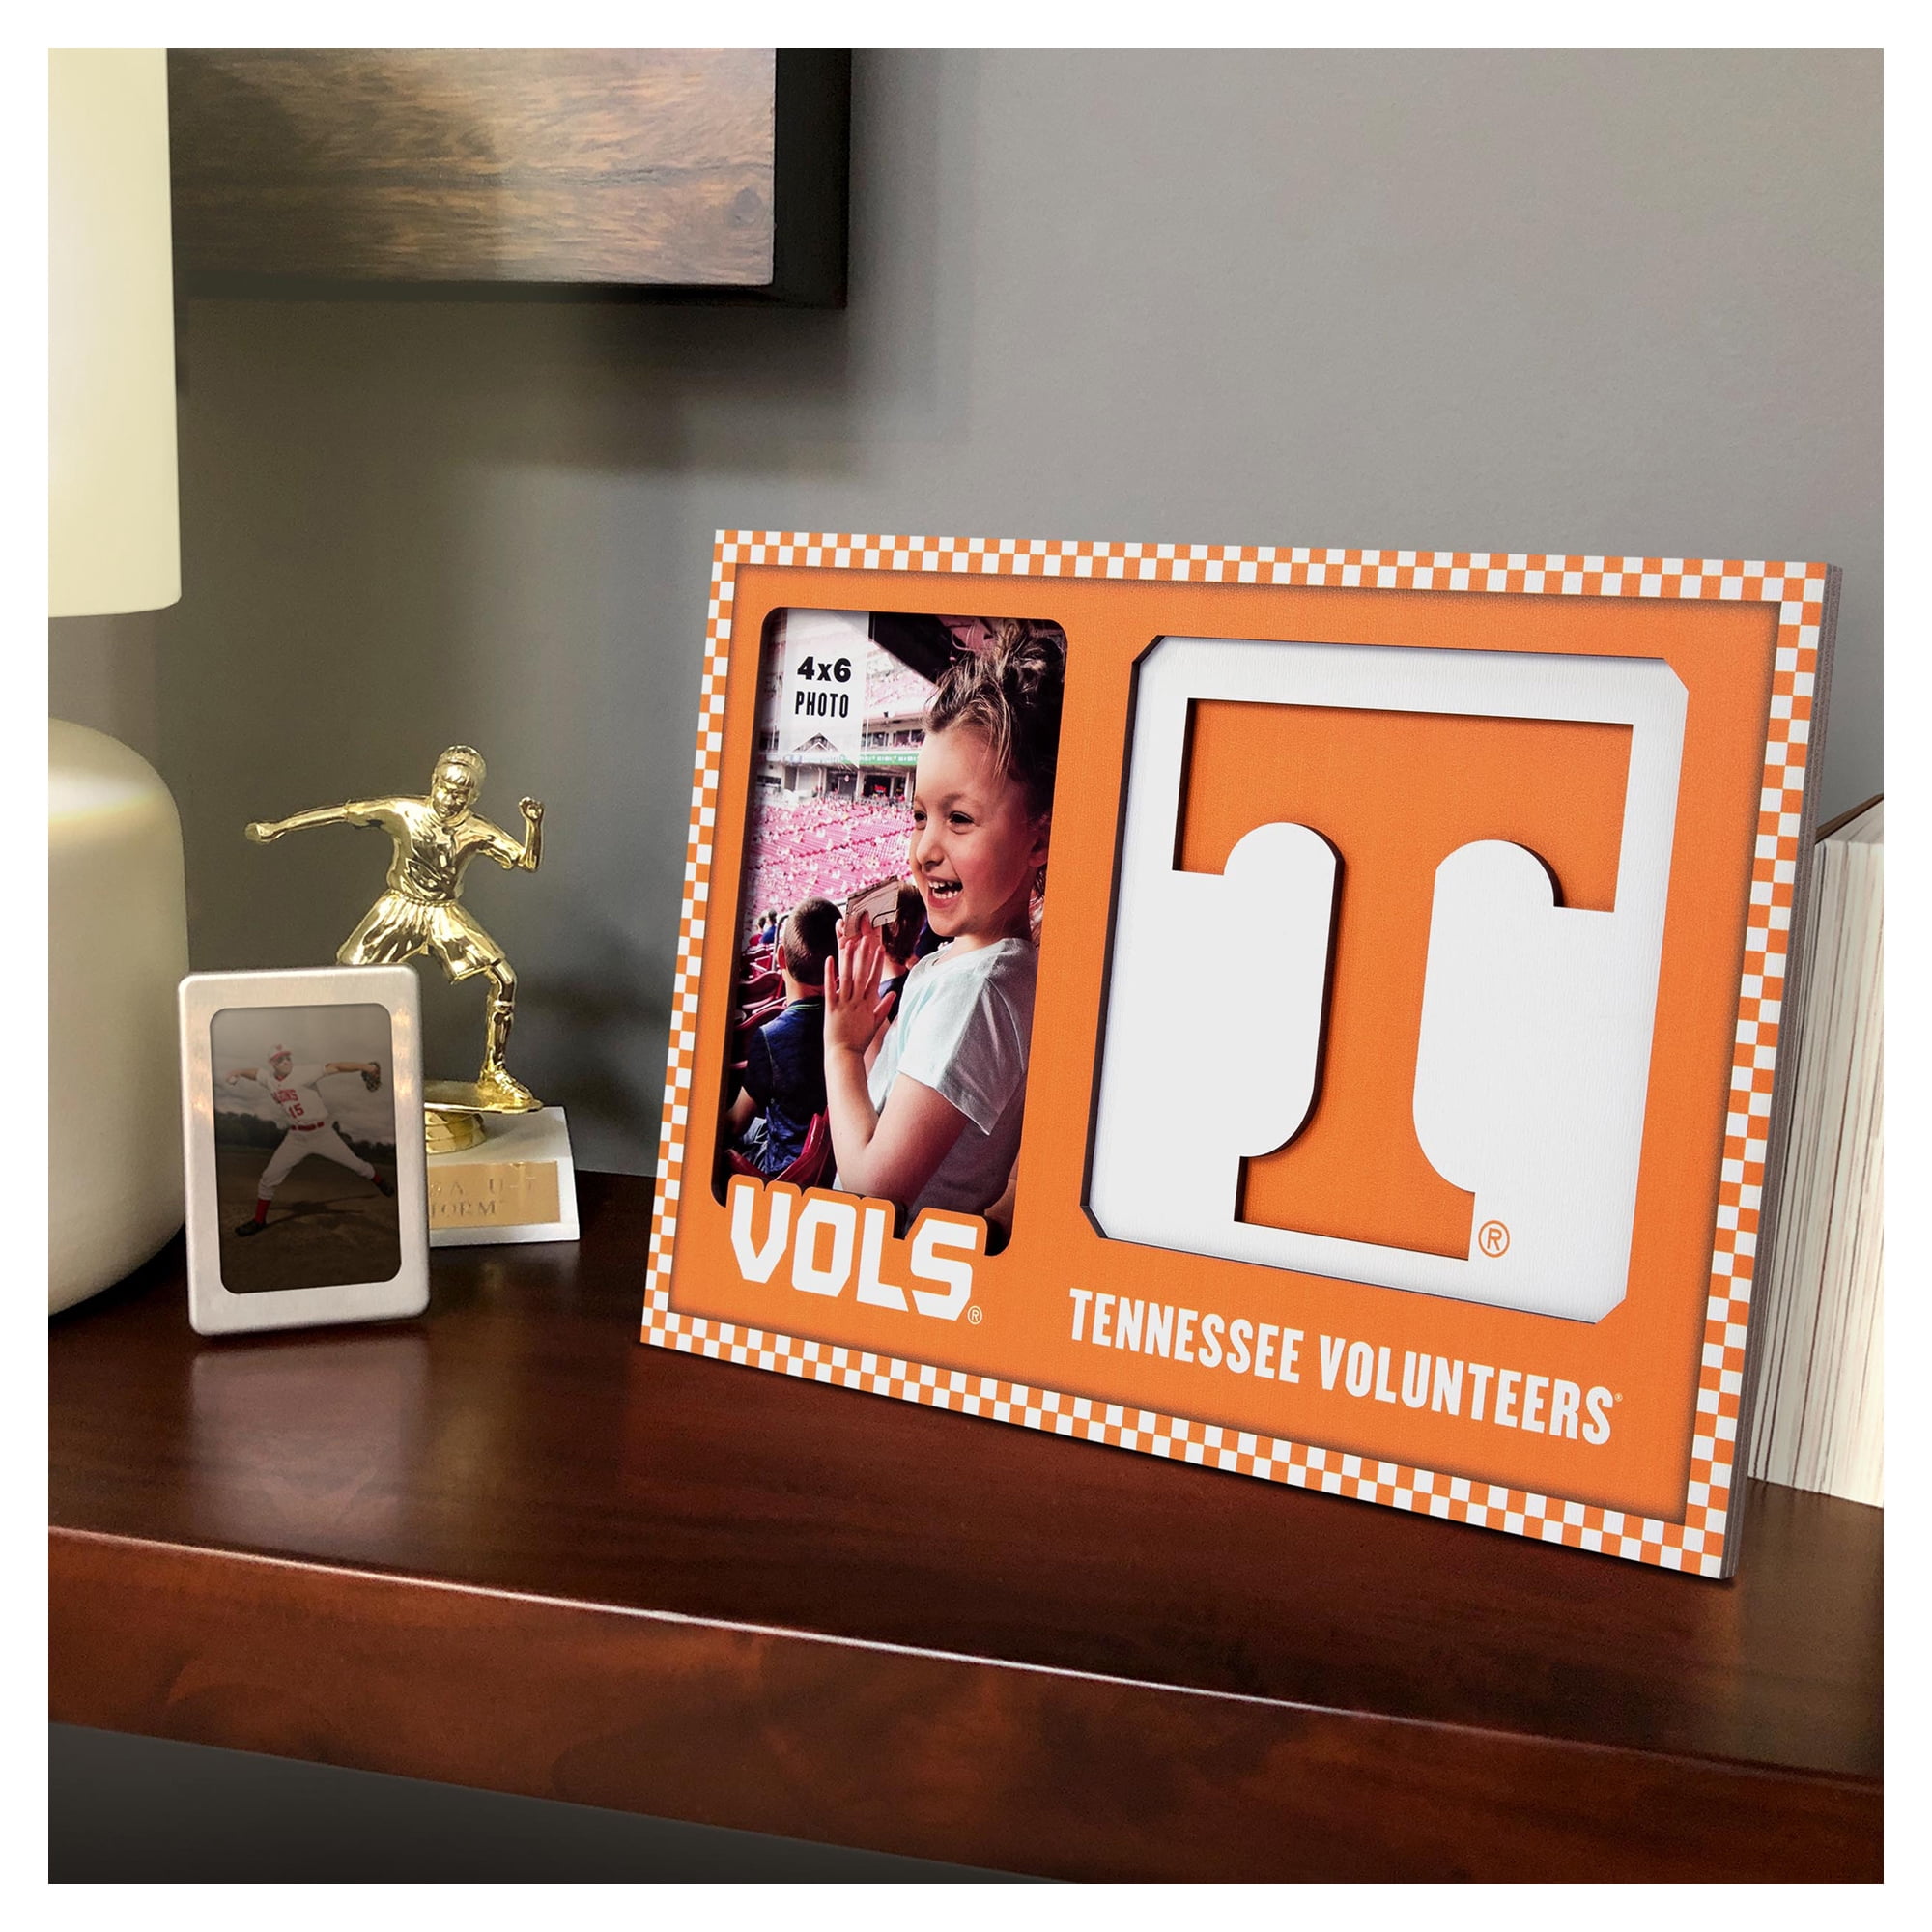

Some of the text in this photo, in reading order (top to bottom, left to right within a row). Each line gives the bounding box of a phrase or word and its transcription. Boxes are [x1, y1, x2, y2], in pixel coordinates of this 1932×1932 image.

[797, 656, 852, 683] 4x6
[795, 691, 849, 718] PHOTO
[1173, 698, 1634, 1260] T
[288, 1103, 305, 1119] 15
[1069, 1288, 1614, 1445] TENNESSEE VOLUNTEERS
